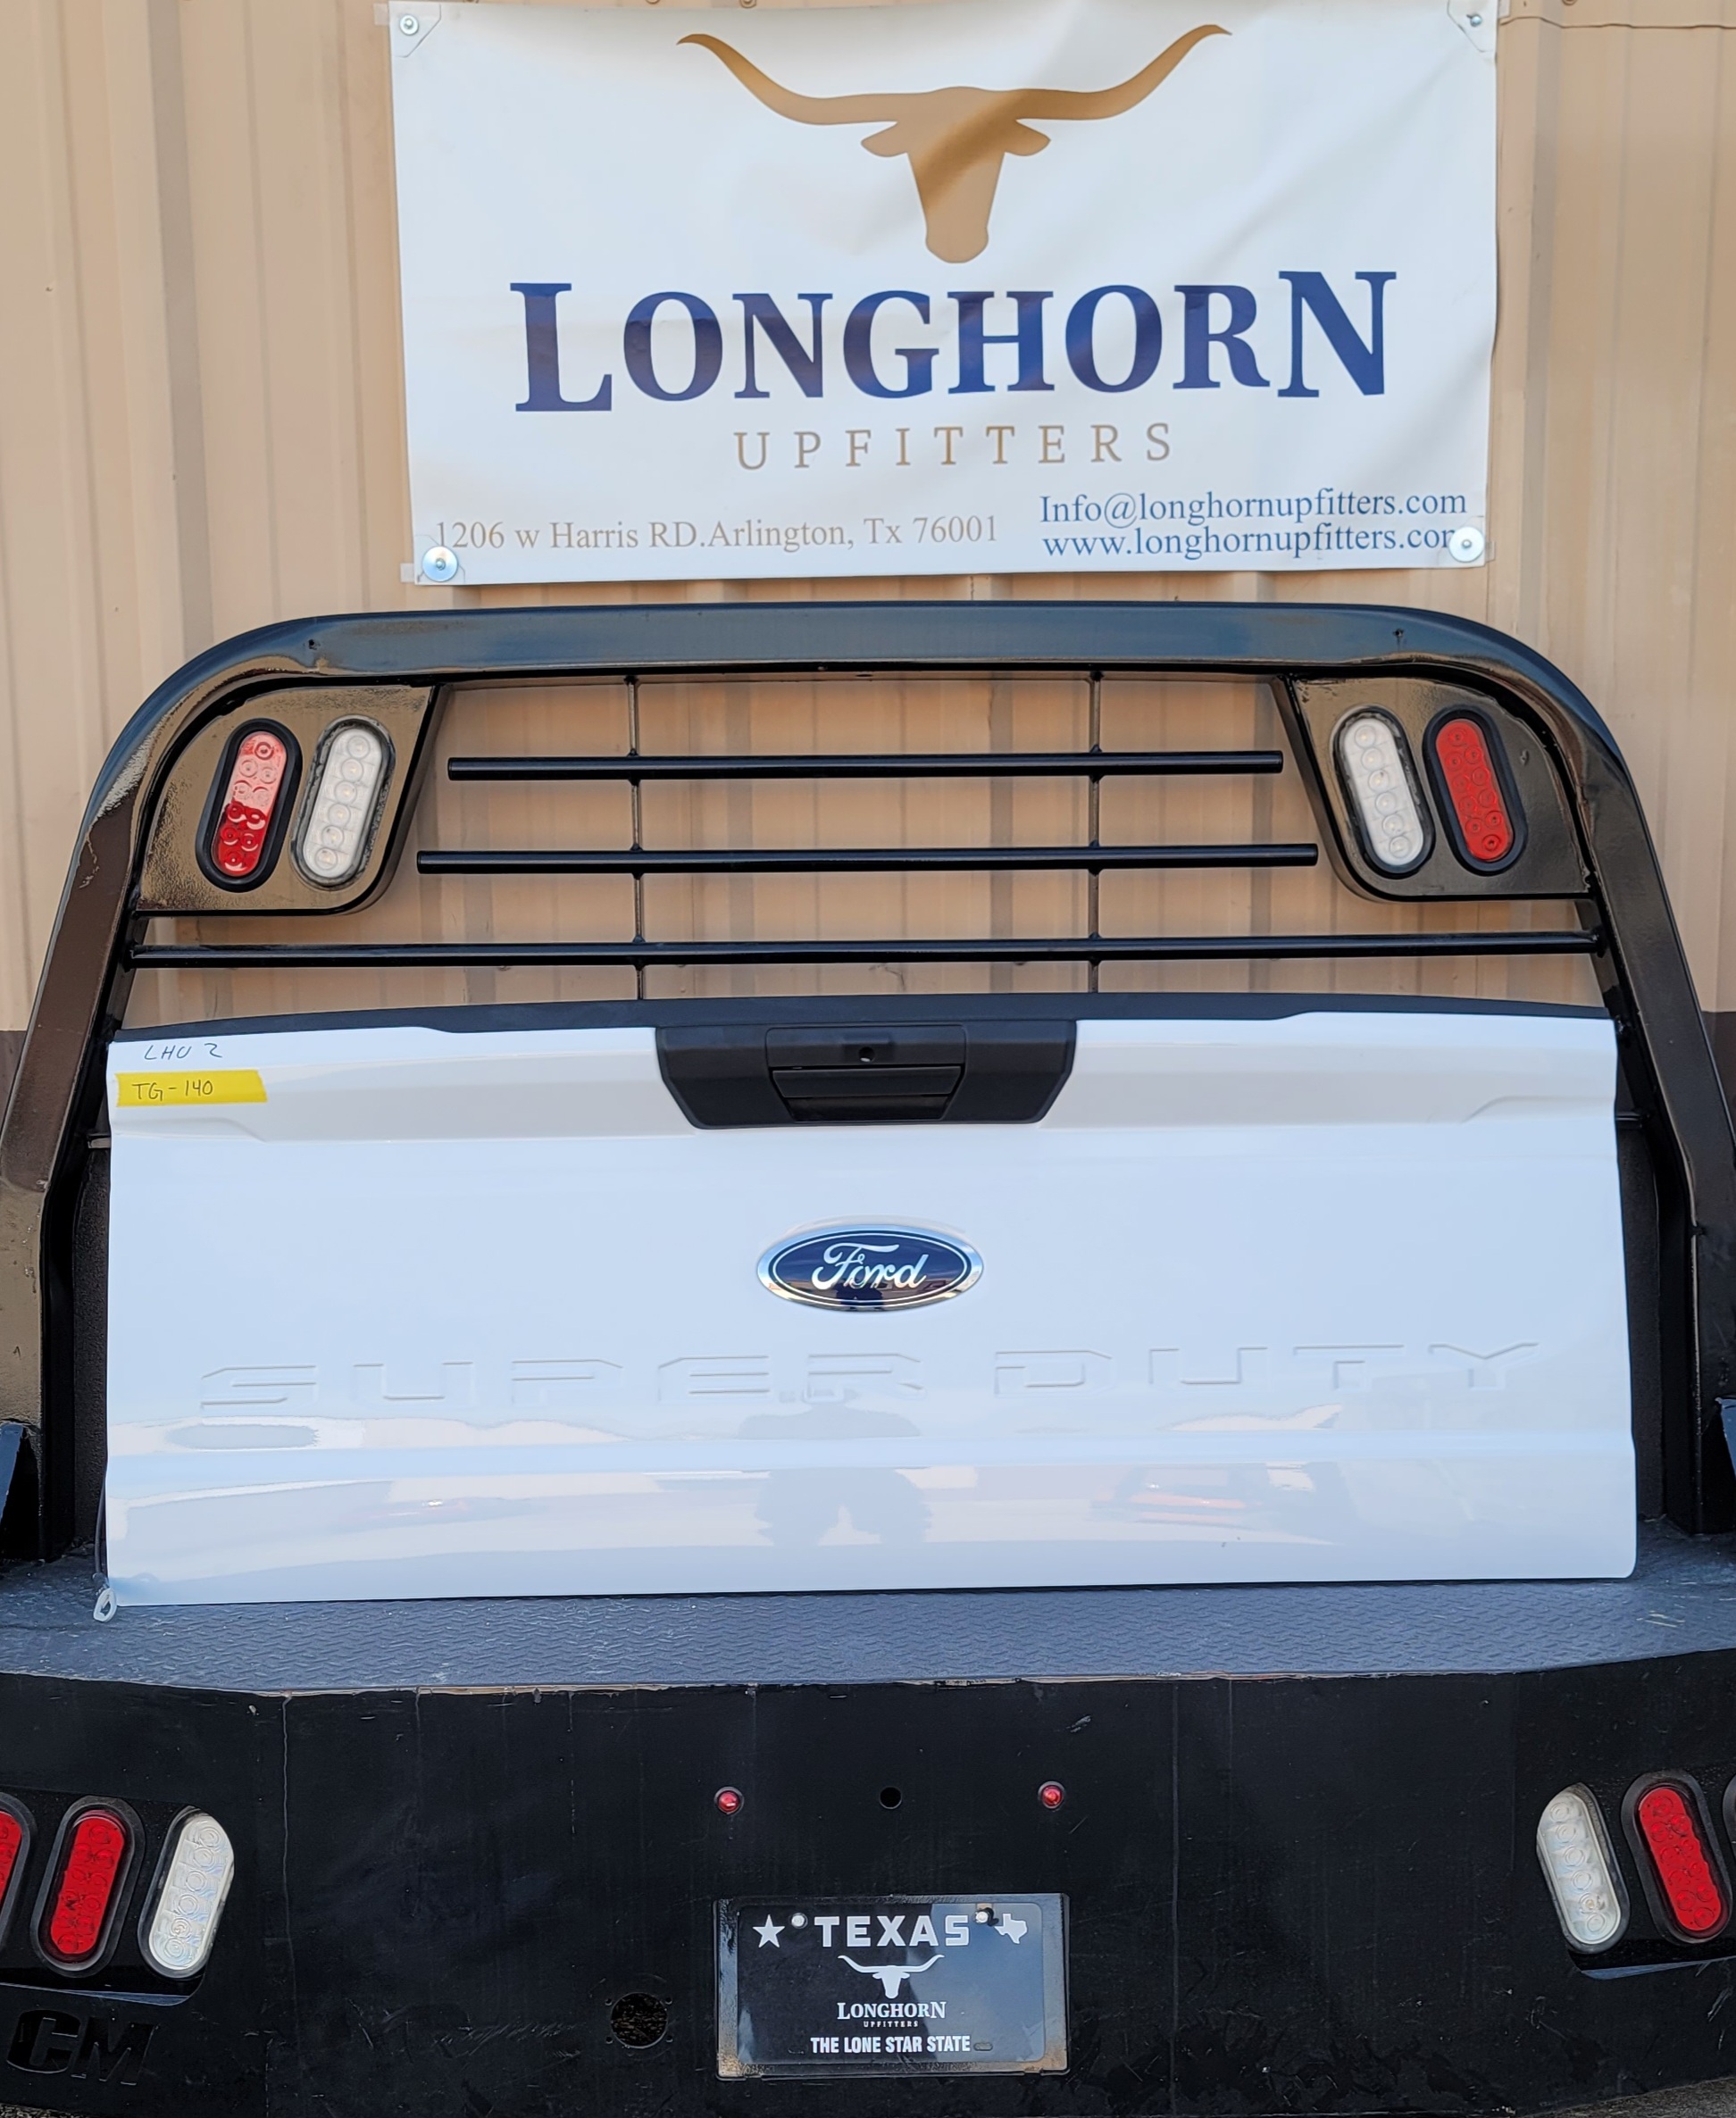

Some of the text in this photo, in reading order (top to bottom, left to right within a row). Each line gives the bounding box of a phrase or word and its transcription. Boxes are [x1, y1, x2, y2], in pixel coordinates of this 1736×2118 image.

[509, 271, 1397, 413] LONGHORN
[733, 422, 1172, 471] UPFITTERS
[1039, 488, 1467, 529] Info@longhornupfitters.com
[437, 521, 505, 548] 1206
[514, 530, 539, 548] w
[549, 520, 639, 548] Harris
[864, 518, 903, 544] Tx
[913, 515, 997, 543] 76001
[204, 1042, 223, 1058] 2
[811, 1242, 926, 1289] Ford
[199, 1342, 1540, 1412] SUPER DUTY
[814, 1914, 971, 1947] TEXAS
[837, 2001, 947, 2020] LONGHORN
[863, 2020, 919, 2028] UPFITTERS
[810, 2036, 971, 2054] THE LONE STAR STATE
